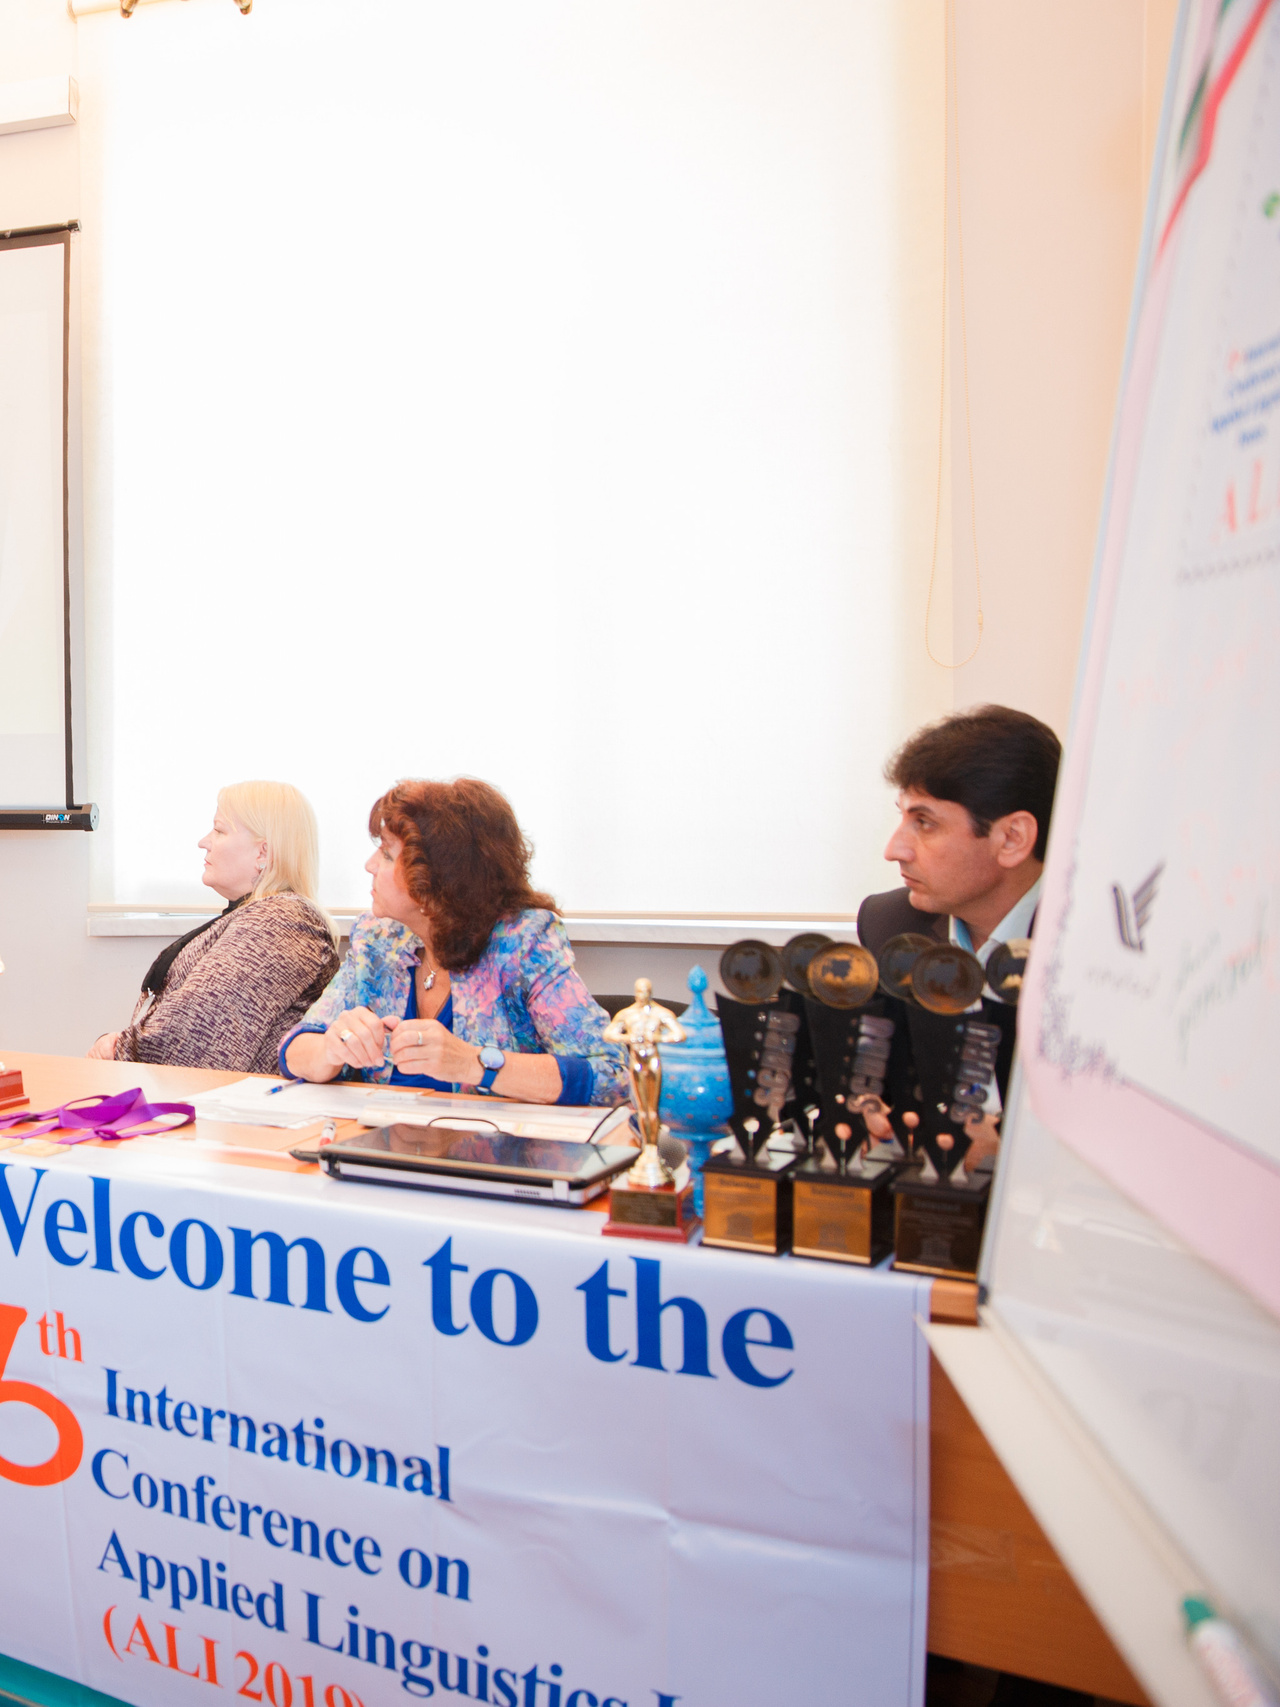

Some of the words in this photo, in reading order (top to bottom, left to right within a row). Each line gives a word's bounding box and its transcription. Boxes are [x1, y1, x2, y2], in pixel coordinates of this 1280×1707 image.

[421, 1237, 540, 1347] to
[576, 1255, 797, 1388] the
[101, 1367, 455, 1503] International
[91, 1448, 382, 1576] Conference
[398, 1544, 473, 1602] on
[97, 1528, 287, 1633] Applied
[301, 1590, 628, 1707] Linguisti
[103, 1604, 224, 1689] (ALI
[234, 1649, 369, 1707] 201
